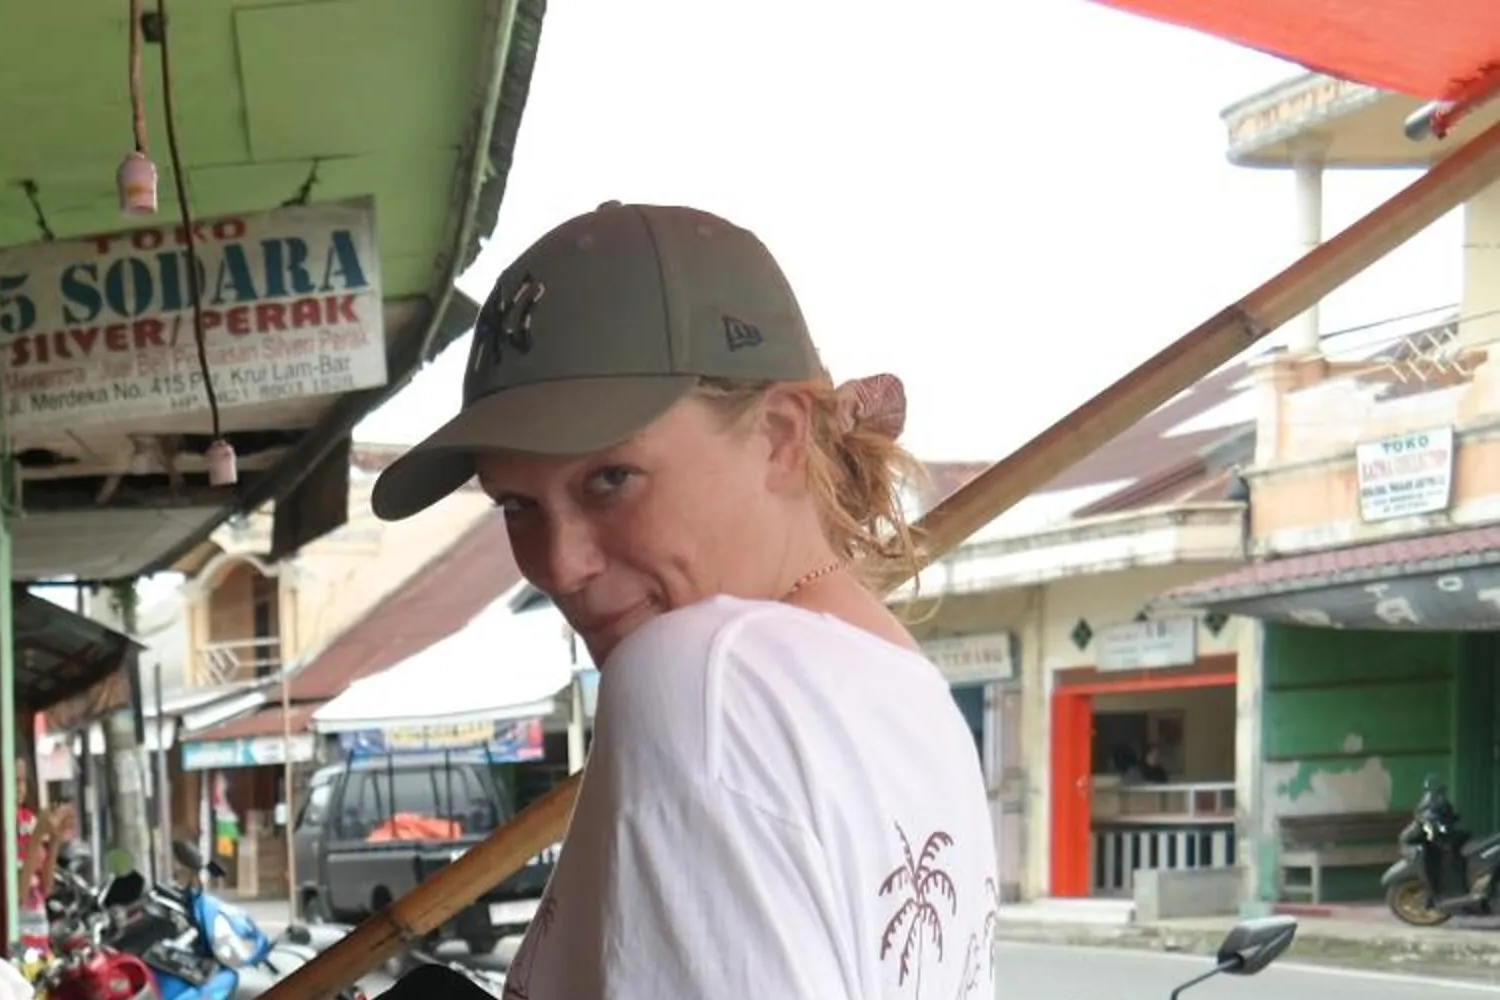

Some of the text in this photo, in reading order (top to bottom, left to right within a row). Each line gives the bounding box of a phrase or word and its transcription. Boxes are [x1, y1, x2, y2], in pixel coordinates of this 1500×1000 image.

[88, 218, 248, 254] TOKO
[0, 229, 369, 334] 5 SODARA
[1381, 435, 1429, 454] TOKO
